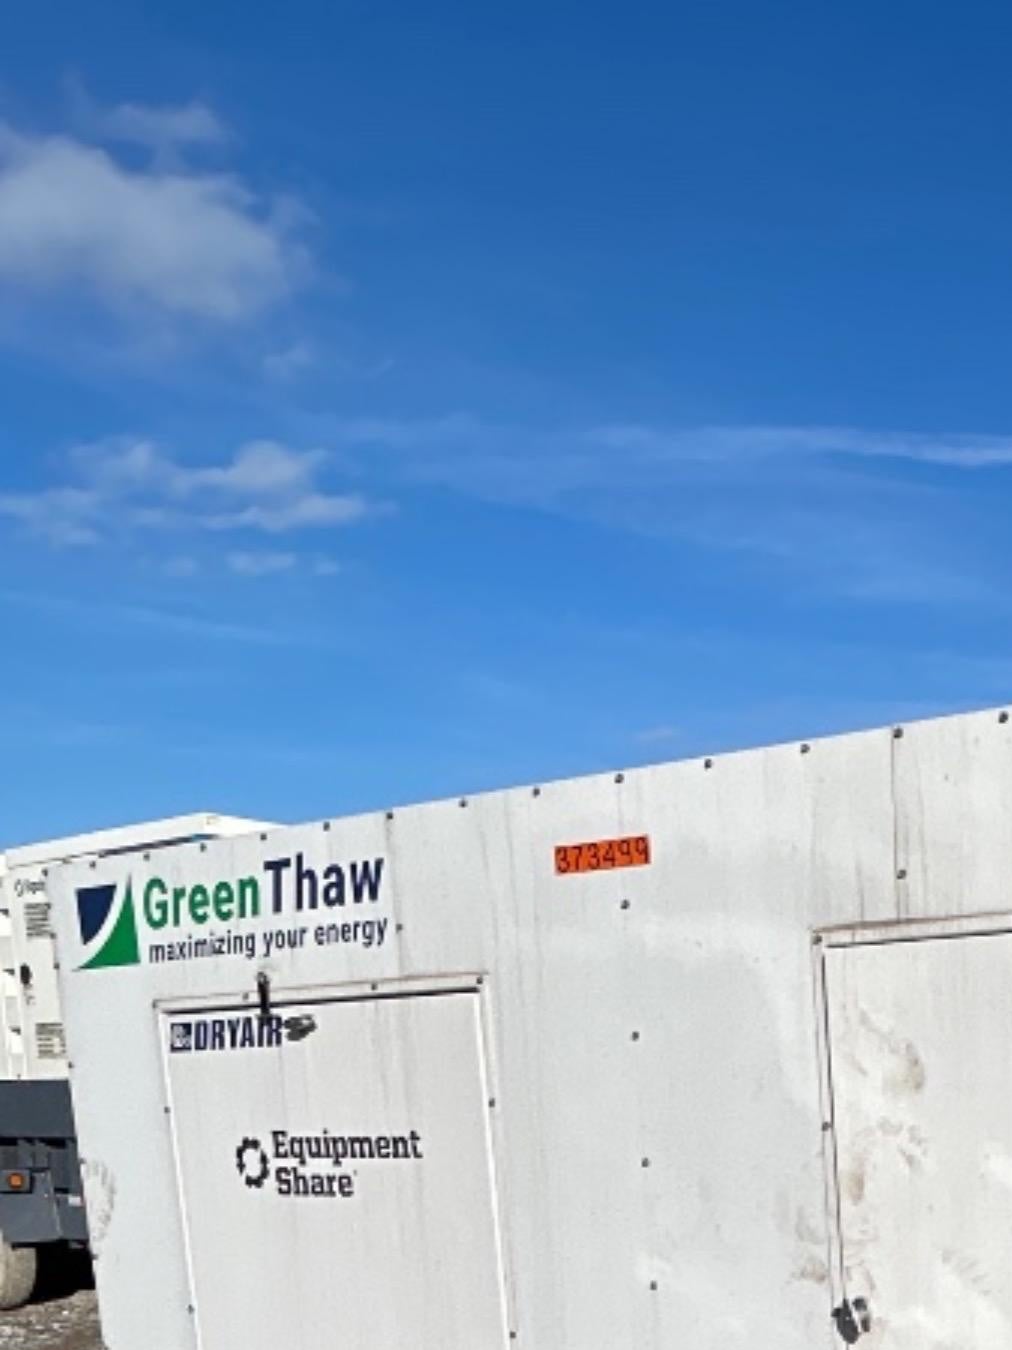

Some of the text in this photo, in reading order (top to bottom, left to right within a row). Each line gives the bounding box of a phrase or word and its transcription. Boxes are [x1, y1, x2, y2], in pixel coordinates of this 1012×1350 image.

[555, 836, 650, 873] 373499
[143, 853, 385, 930] GreenThaw
[149, 917, 388, 963] maximizing your energy
[271, 1127, 424, 1167] Equipment
[274, 1166, 355, 1198] Share
